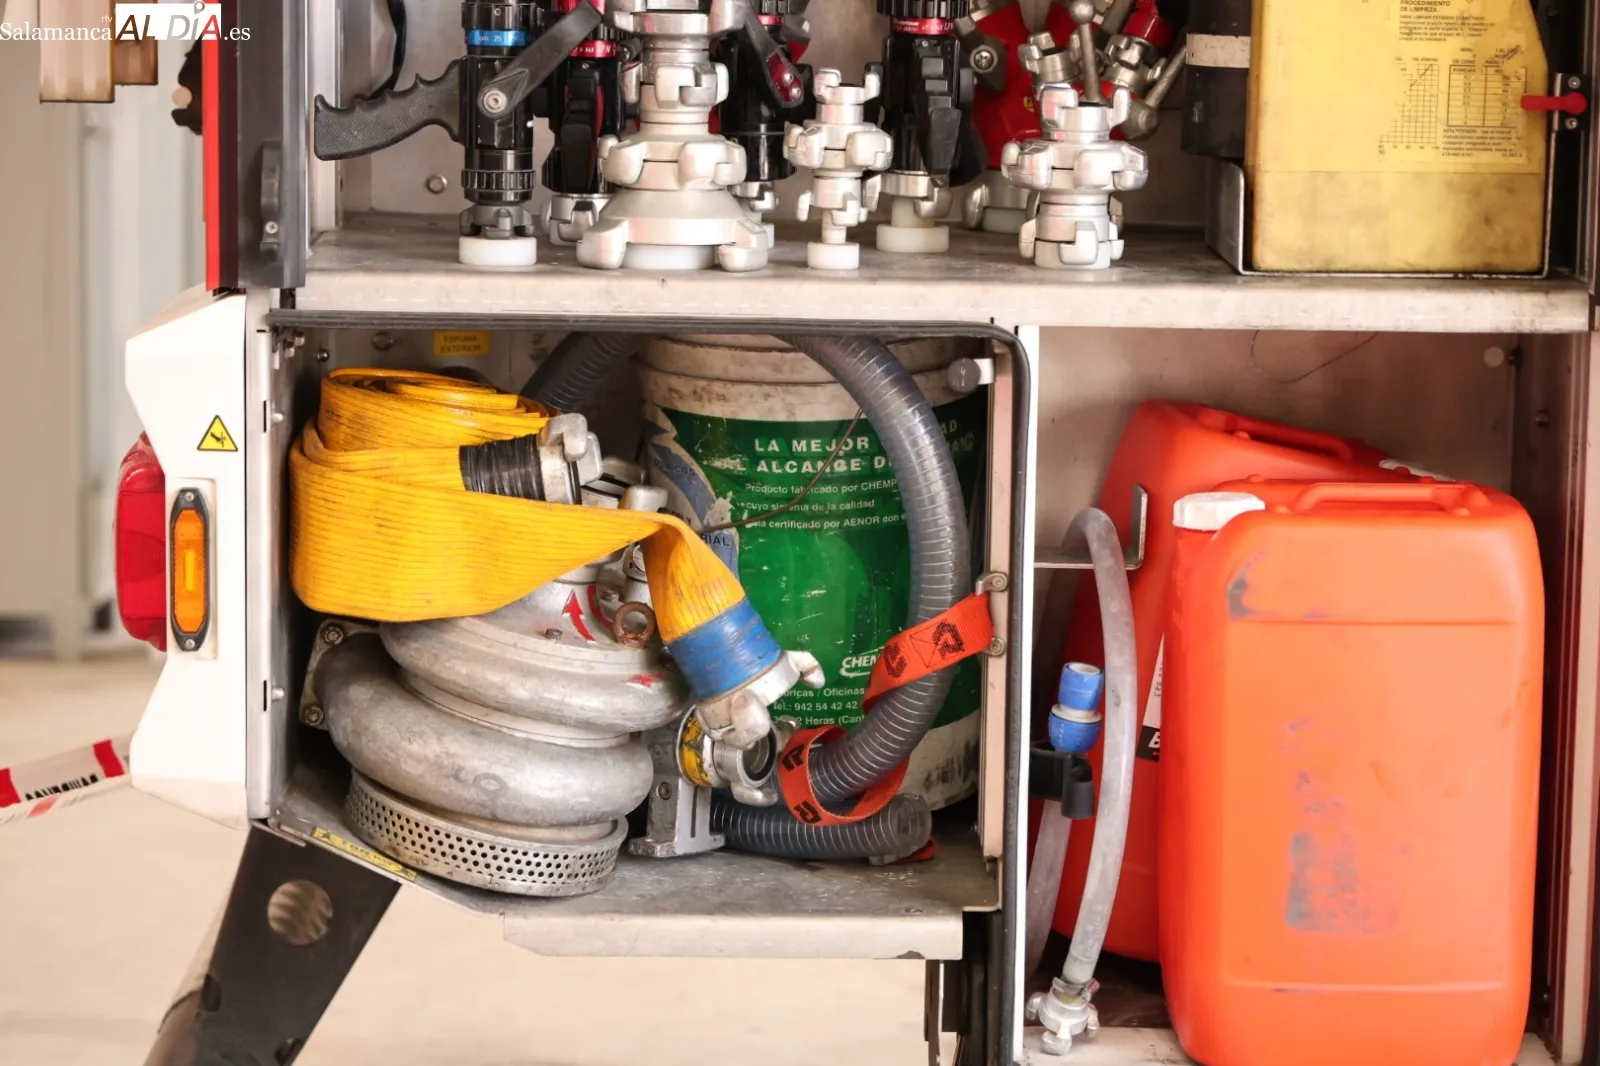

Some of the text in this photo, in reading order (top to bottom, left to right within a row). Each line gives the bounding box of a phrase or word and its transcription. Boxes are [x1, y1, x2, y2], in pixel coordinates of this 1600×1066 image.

[443, 334, 478, 342] ESPUMA
[440, 344, 482, 353] EXTERIOR
[754, 436, 870, 452] LA MEJOR
[873, 455, 892, 470] D
[745, 482, 788, 494] Producto
[841, 484, 858, 494] por
[861, 478, 898, 491] CHEMP
[746, 502, 768, 512] cuyo
[839, 499, 875, 510] calidad
[769, 520, 820, 529] certificado
[824, 520, 840, 530] por
[843, 515, 880, 527] AENOR
[824, 688, 864, 697] Oficinas
[794, 702, 812, 711] 942
[816, 702, 828, 710] 54
[830, 702, 842, 710] 42
[846, 700, 858, 710] 42
[806, 716, 835, 725] Heras
